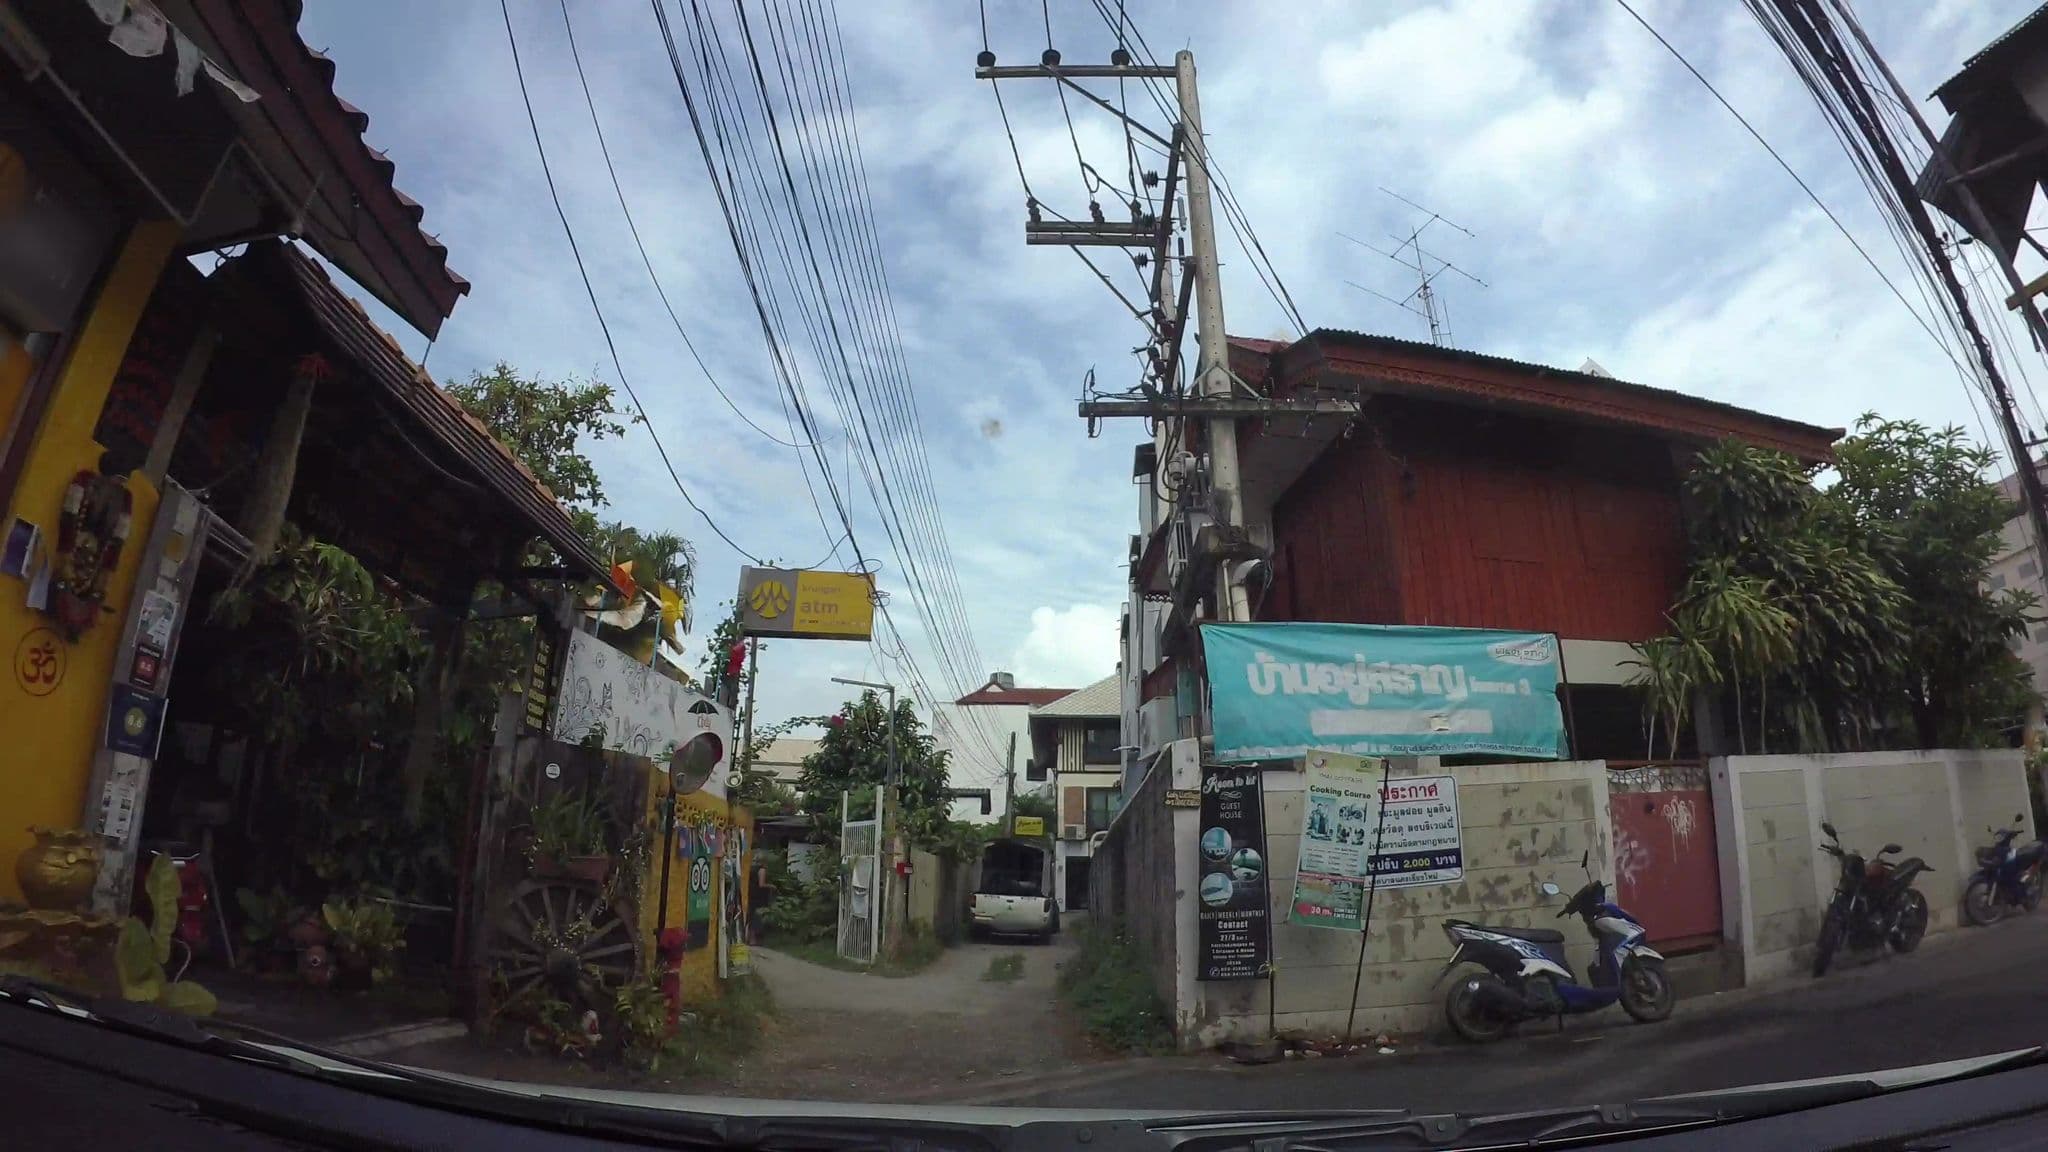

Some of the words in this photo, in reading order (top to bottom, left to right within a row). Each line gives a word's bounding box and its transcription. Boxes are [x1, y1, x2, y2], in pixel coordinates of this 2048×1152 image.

[800, 601, 839, 614] atm
[1310, 784, 1342, 798] Cooking
[1344, 789, 1372, 800] Course
[1220, 802, 1241, 811] GUEST
[1219, 810, 1242, 819] HOUSE
[1217, 911, 1238, 919] WEEKLY
[1240, 909, 1265, 918] MONTHLY
[1217, 920, 1248, 929] Contact
